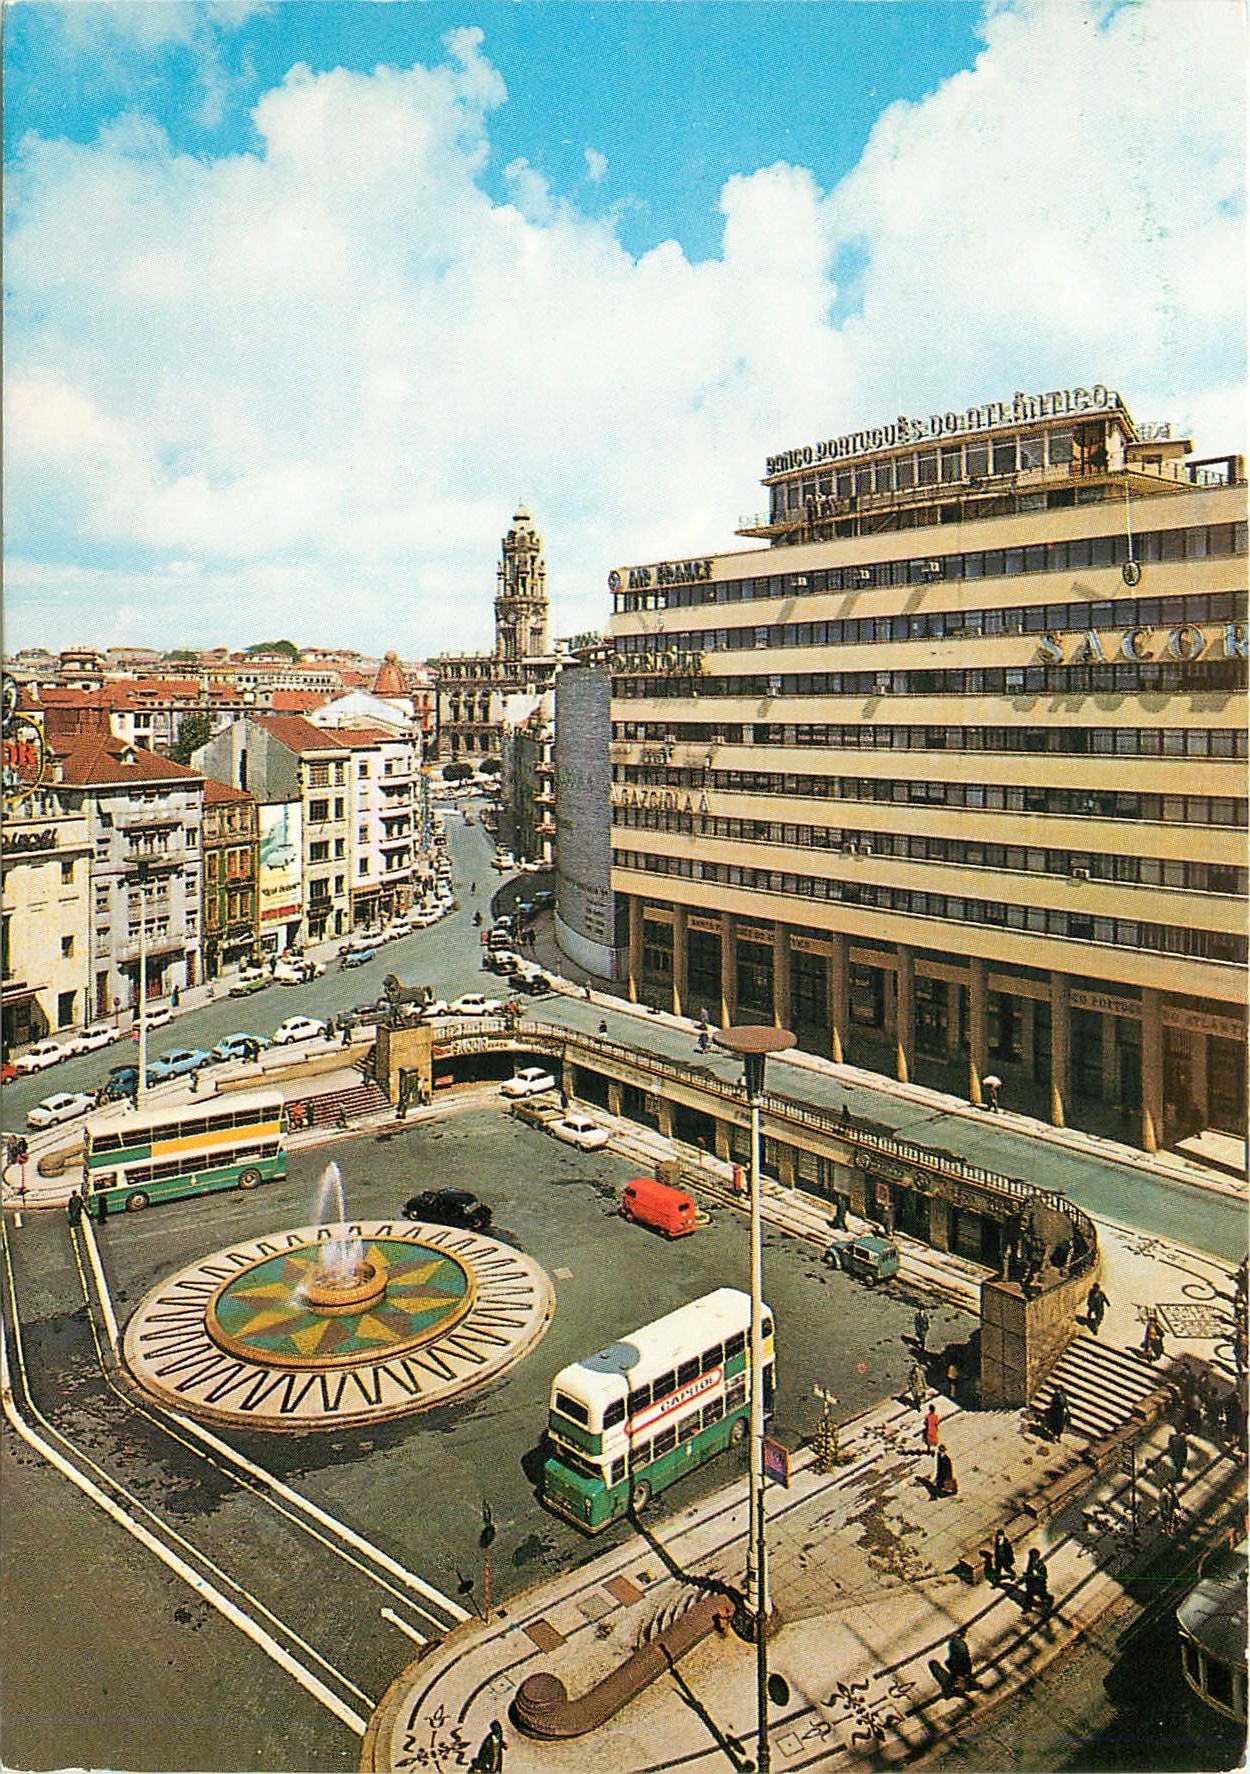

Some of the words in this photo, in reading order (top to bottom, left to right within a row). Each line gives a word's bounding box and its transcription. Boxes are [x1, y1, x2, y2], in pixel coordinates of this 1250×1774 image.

[929, 411, 958, 438] DO
[628, 566, 650, 589] AIR
[656, 559, 713, 586] FRANCE
